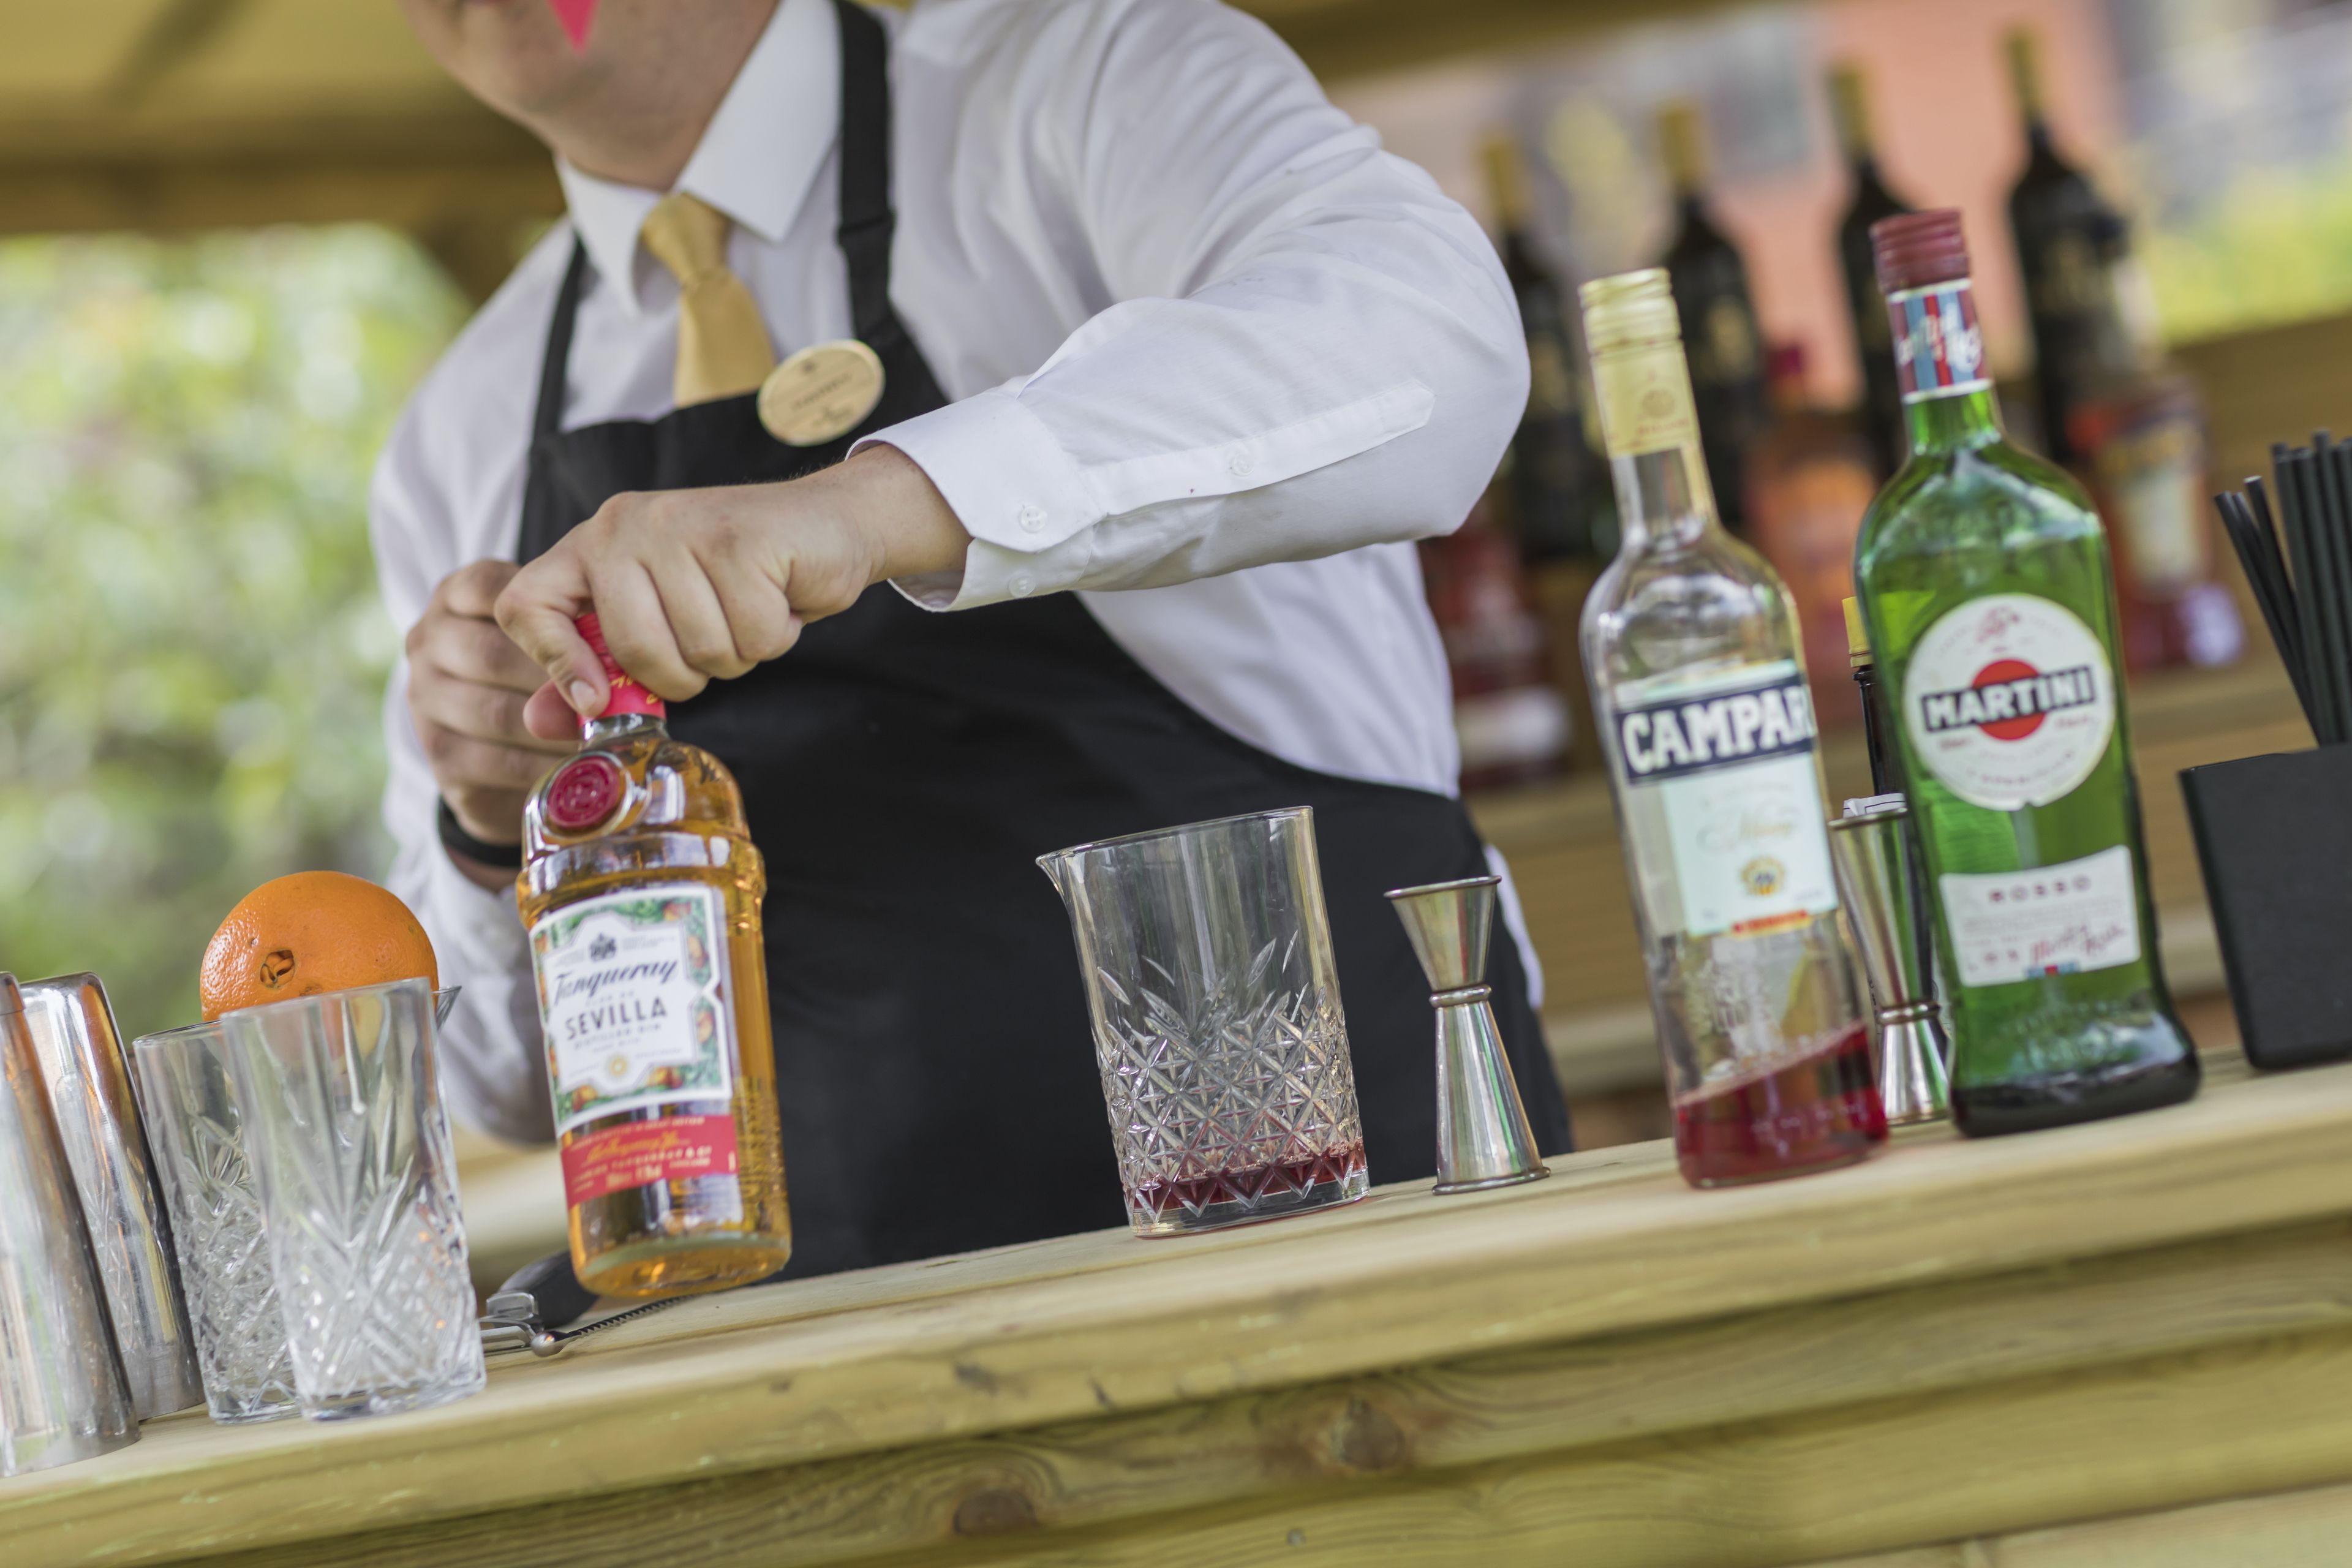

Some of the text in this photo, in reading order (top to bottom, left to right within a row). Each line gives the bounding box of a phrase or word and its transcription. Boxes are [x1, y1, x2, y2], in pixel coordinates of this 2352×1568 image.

[1925, 670, 2092, 729] MARTINI
[553, 960, 678, 1006] Tanqueray
[565, 997, 668, 1041] SEVILLA
